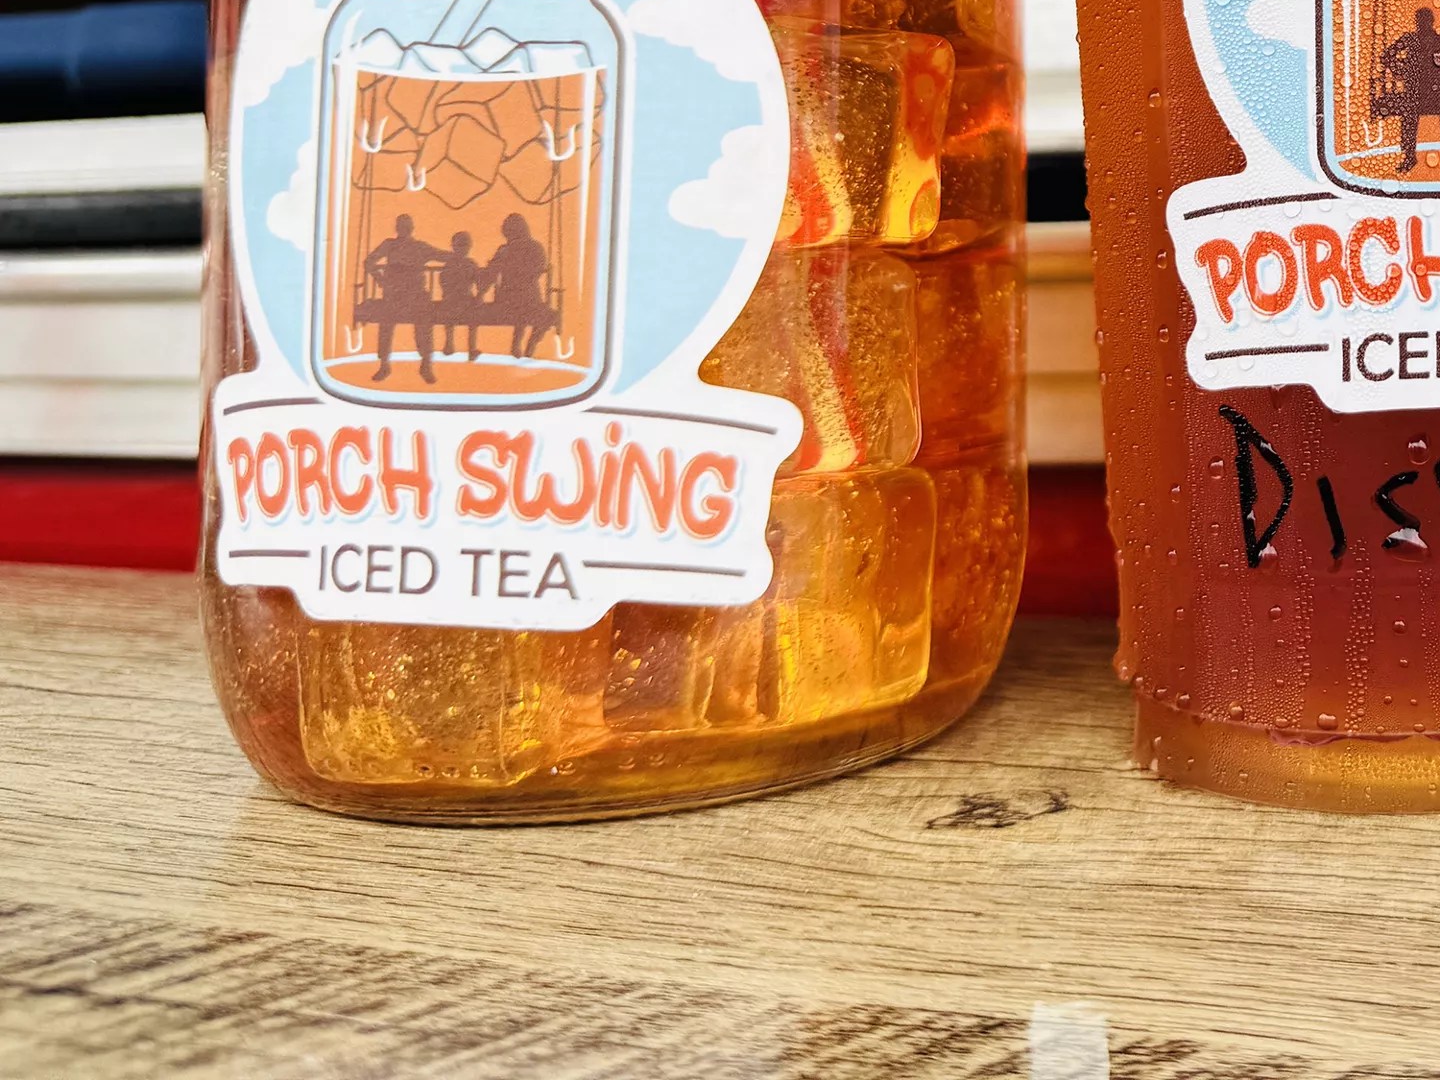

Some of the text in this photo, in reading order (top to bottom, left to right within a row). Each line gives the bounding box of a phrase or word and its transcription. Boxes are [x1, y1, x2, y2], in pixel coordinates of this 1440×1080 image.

[225, 425, 436, 524] PORCH
[317, 542, 582, 602] ICED TEA
